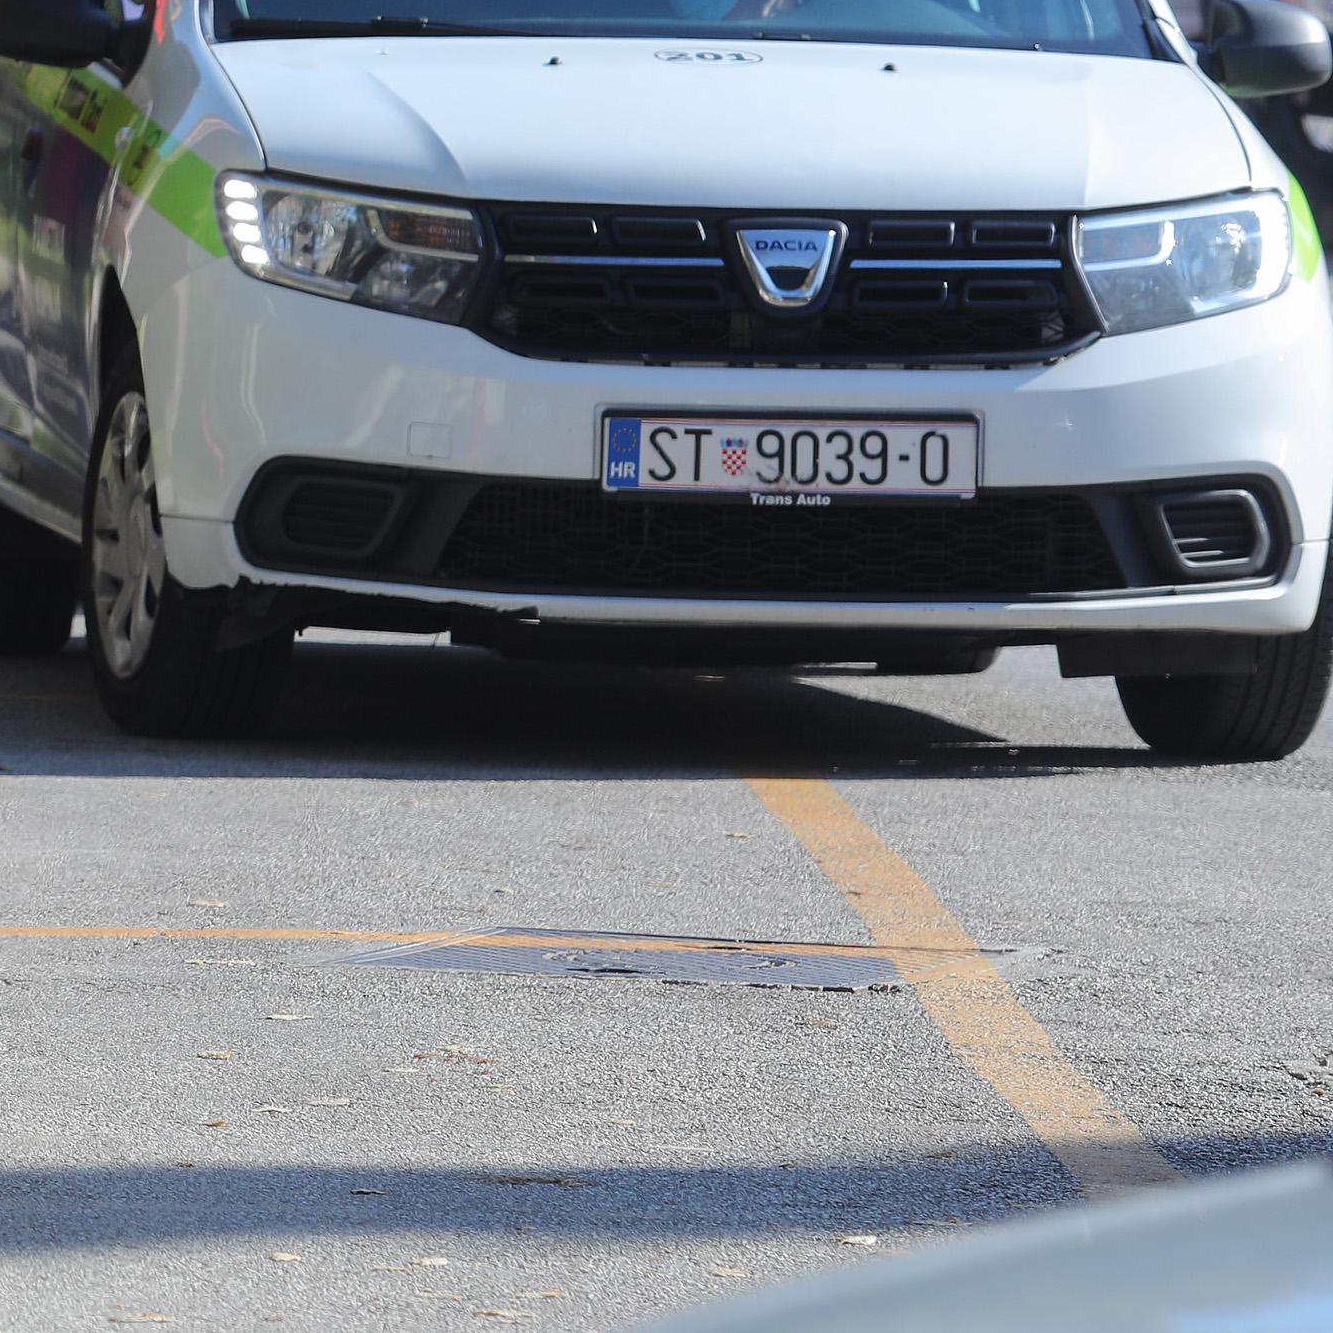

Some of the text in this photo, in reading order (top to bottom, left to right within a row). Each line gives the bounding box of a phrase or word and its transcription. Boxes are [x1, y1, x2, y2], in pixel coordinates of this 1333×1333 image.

[665, 50, 755, 62] 201
[755, 239, 819, 252] DACIA
[648, 425, 713, 482] ST
[609, 461, 636, 479] HR
[749, 492, 832, 506] Trans Auto
